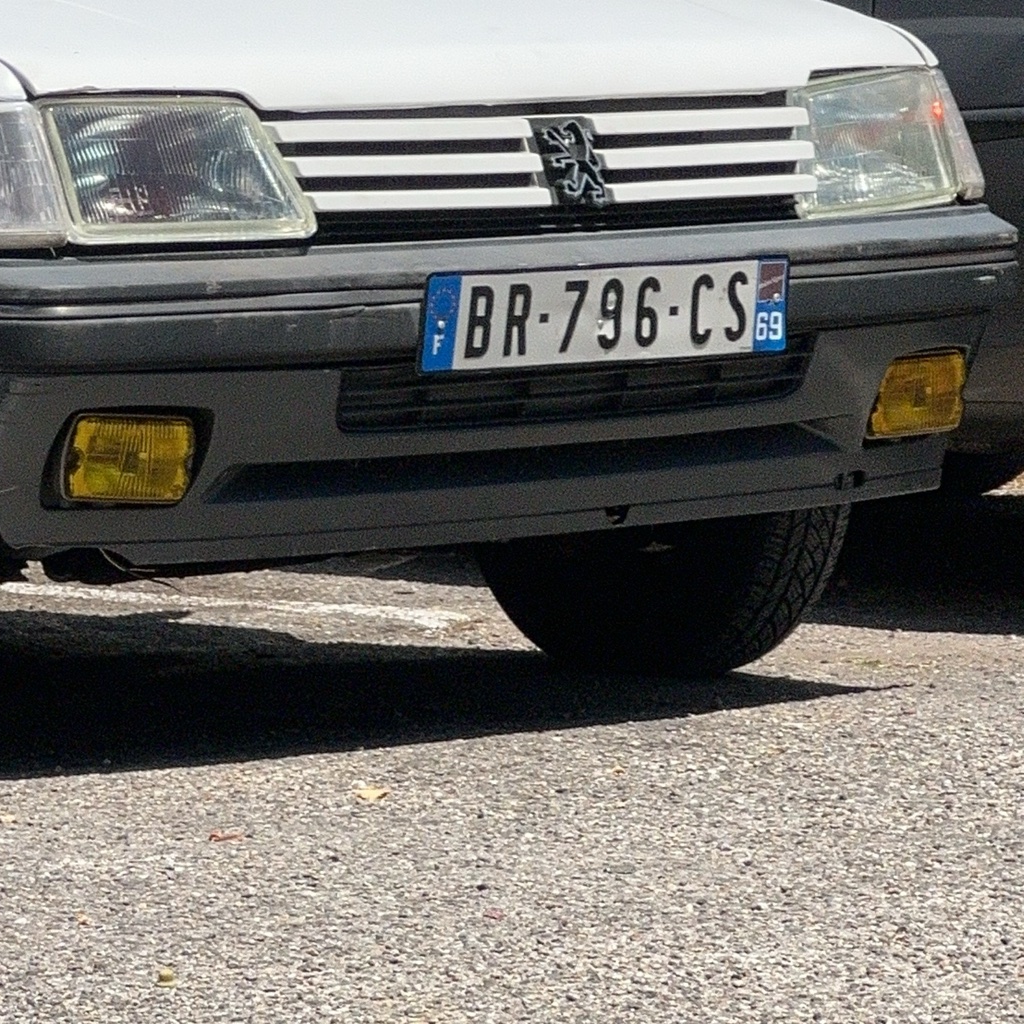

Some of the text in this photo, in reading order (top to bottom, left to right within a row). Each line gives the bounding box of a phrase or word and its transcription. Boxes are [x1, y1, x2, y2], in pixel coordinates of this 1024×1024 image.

[464, 271, 749, 359] BR-796-CS
[756, 310, 783, 341] 69
[432, 334, 445, 355] F
